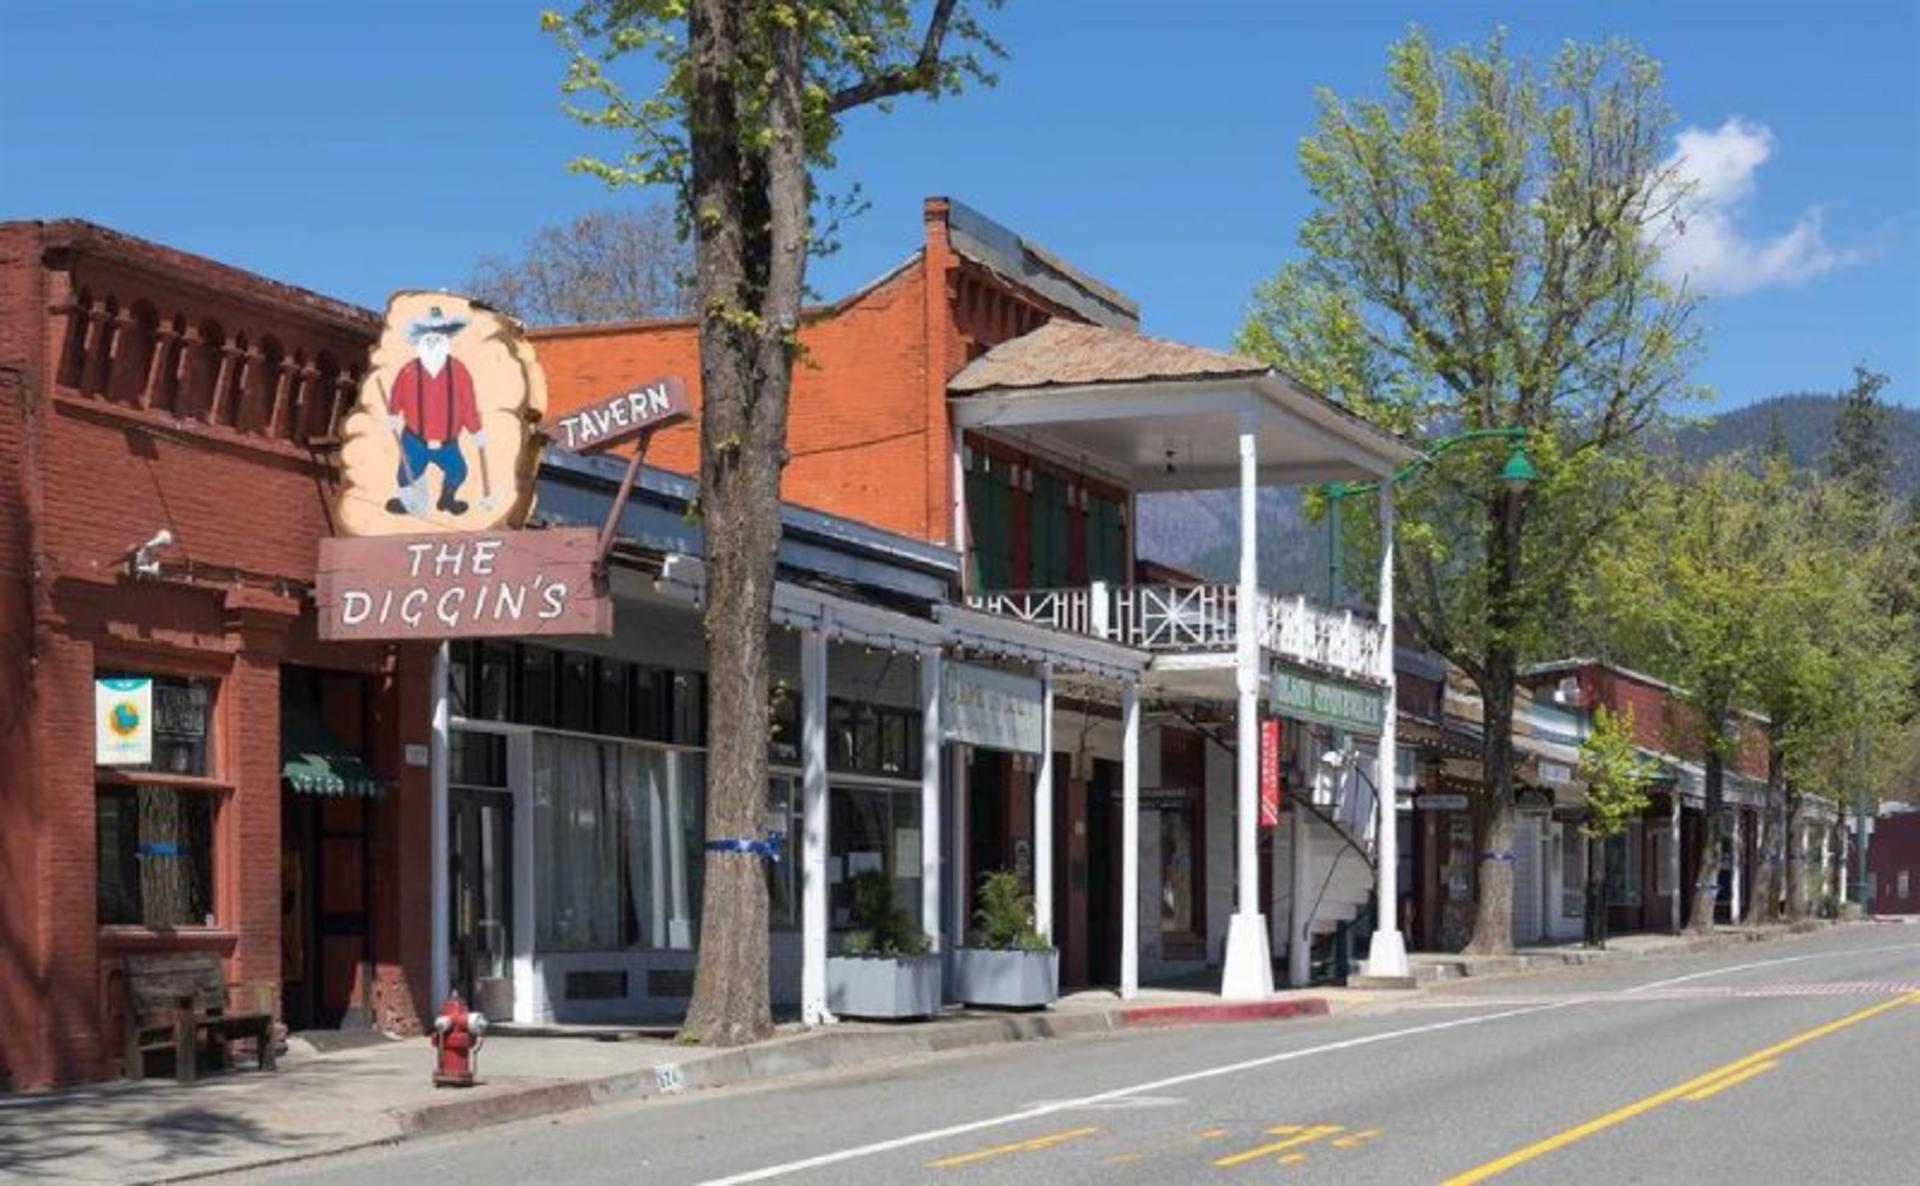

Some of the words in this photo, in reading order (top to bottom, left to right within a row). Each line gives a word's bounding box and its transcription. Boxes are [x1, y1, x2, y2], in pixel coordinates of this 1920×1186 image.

[558, 383, 670, 448] TAVERN
[407, 539, 503, 577] THE
[342, 575, 567, 628] DIGGIN'S
